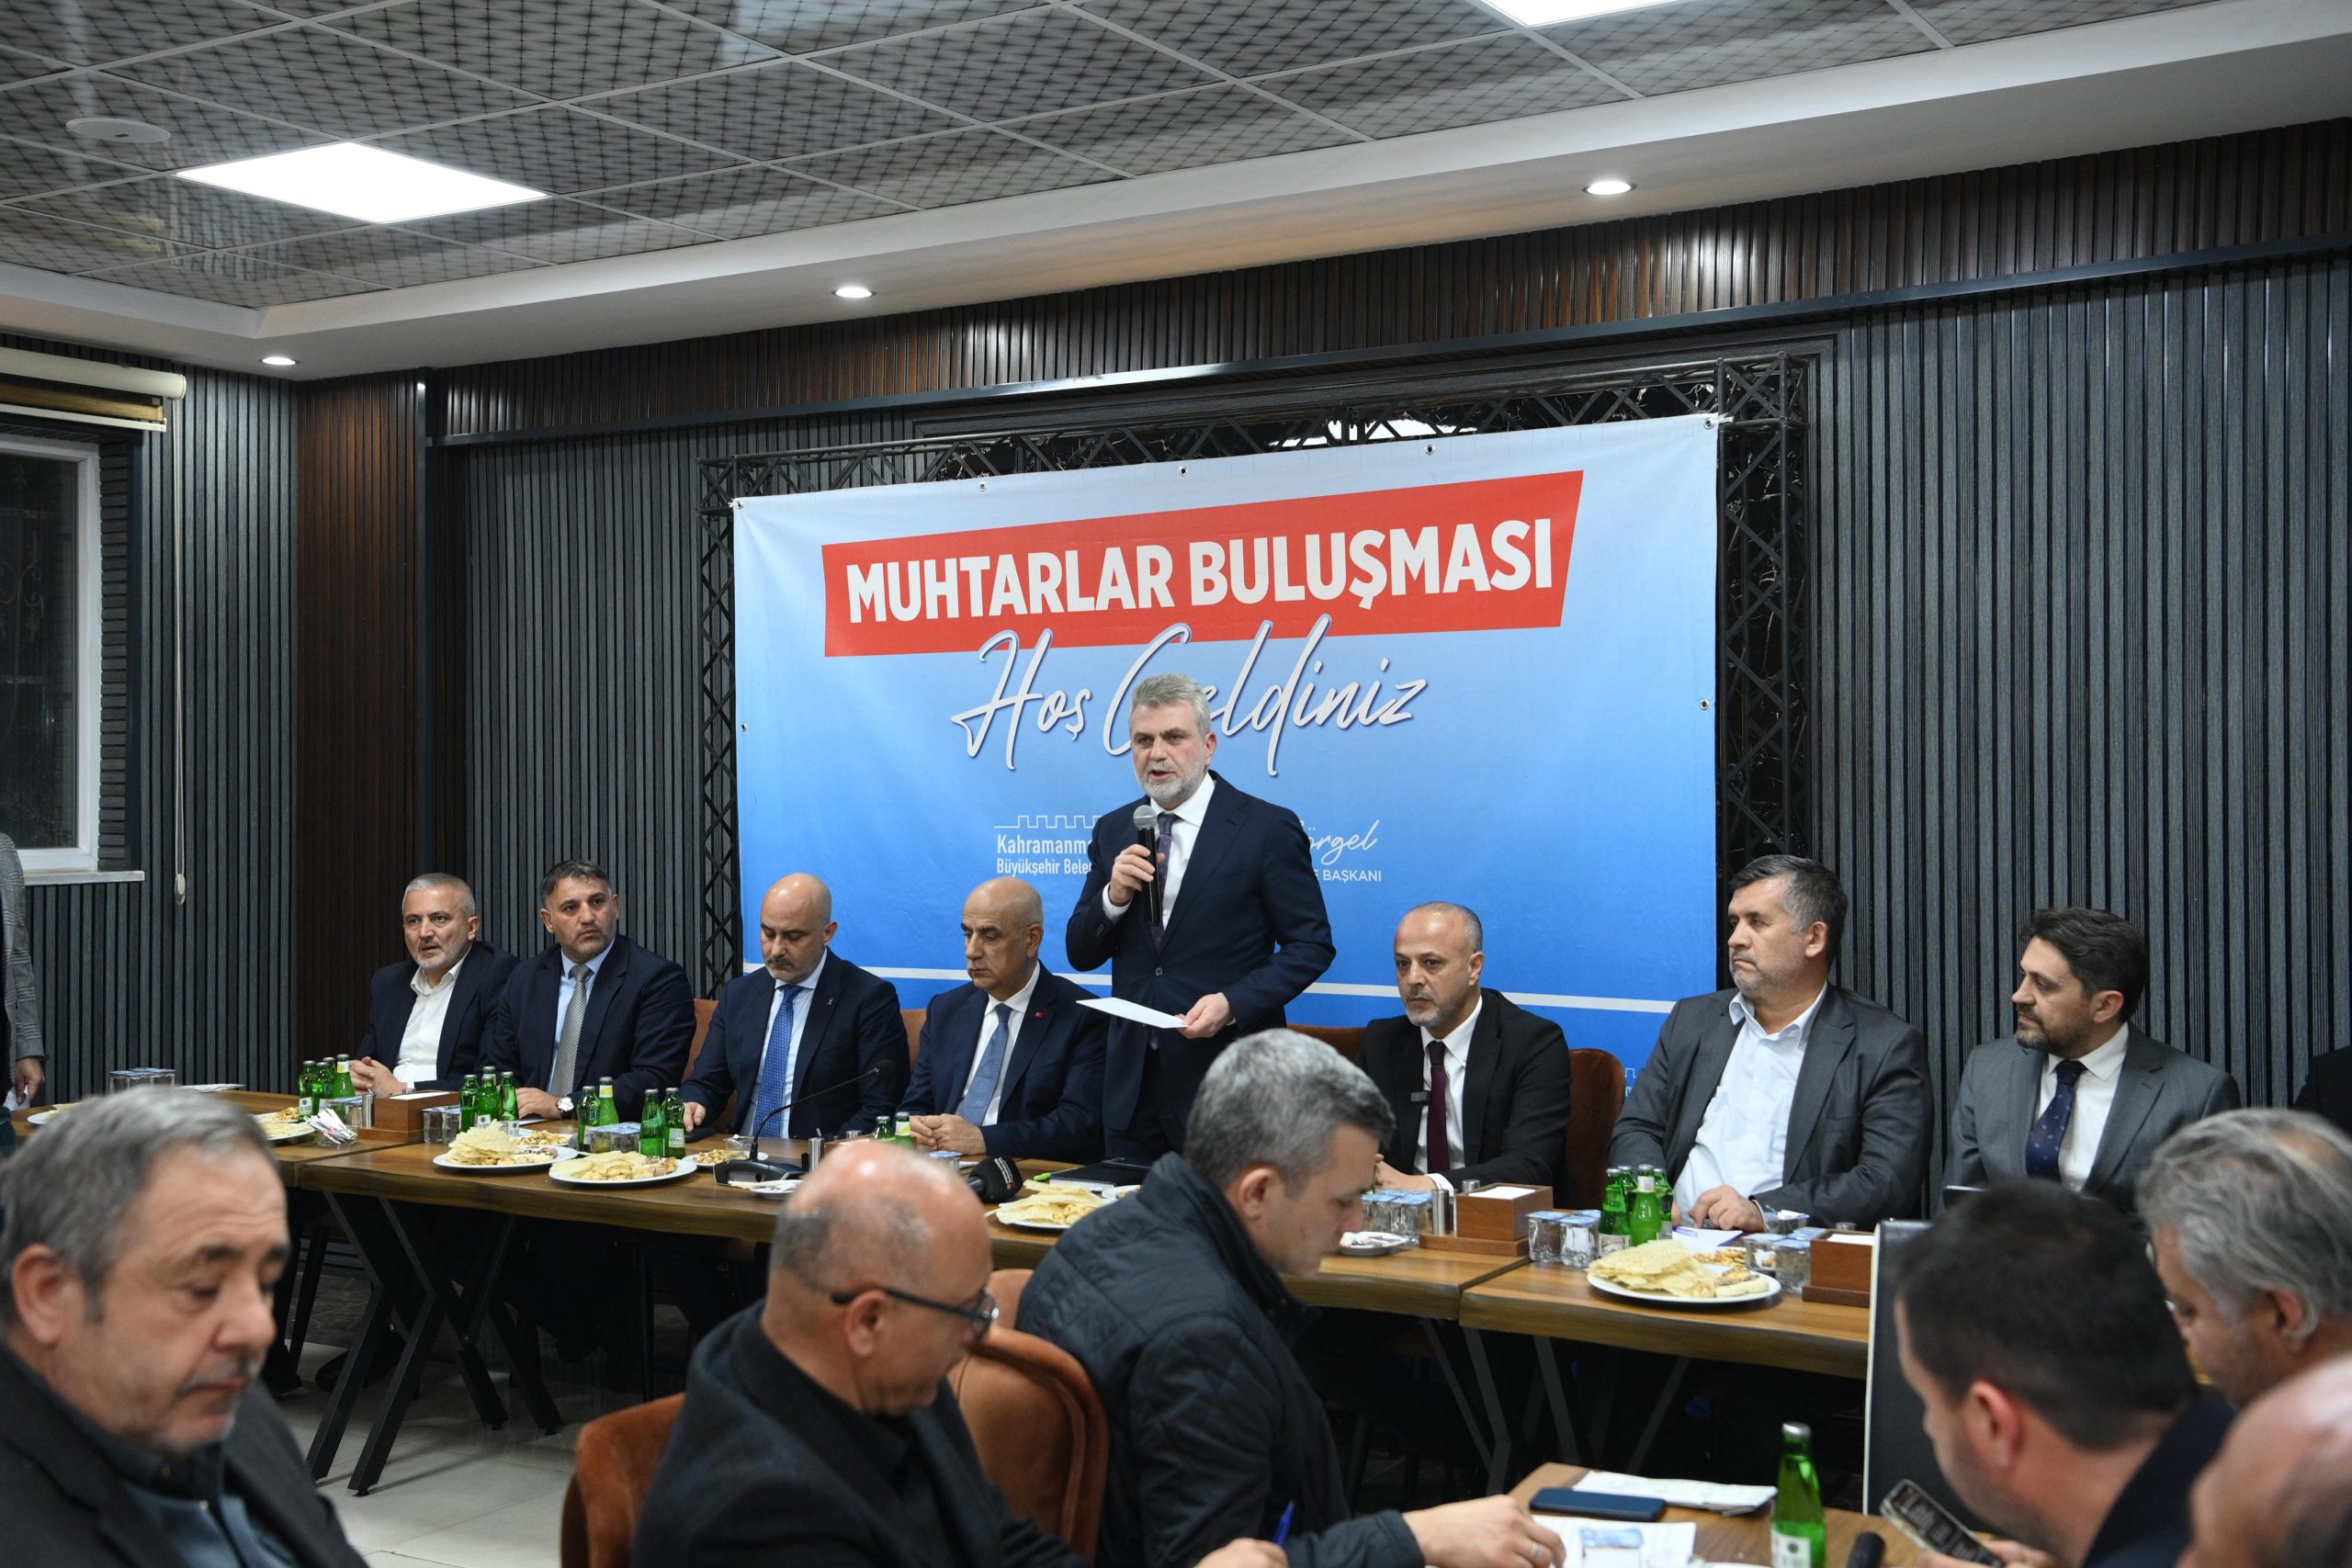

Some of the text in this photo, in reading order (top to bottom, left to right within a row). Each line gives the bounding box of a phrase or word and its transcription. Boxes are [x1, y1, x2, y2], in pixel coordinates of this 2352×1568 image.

[846, 518, 1552, 623] MUHTARLAR BULUŞMASI
[951, 628, 1091, 771] Hoş
[997, 834, 1091, 854] Kahramanm
[997, 858, 1060, 877] Büyükşehir
[1323, 870, 1382, 884] BAŞKANI
